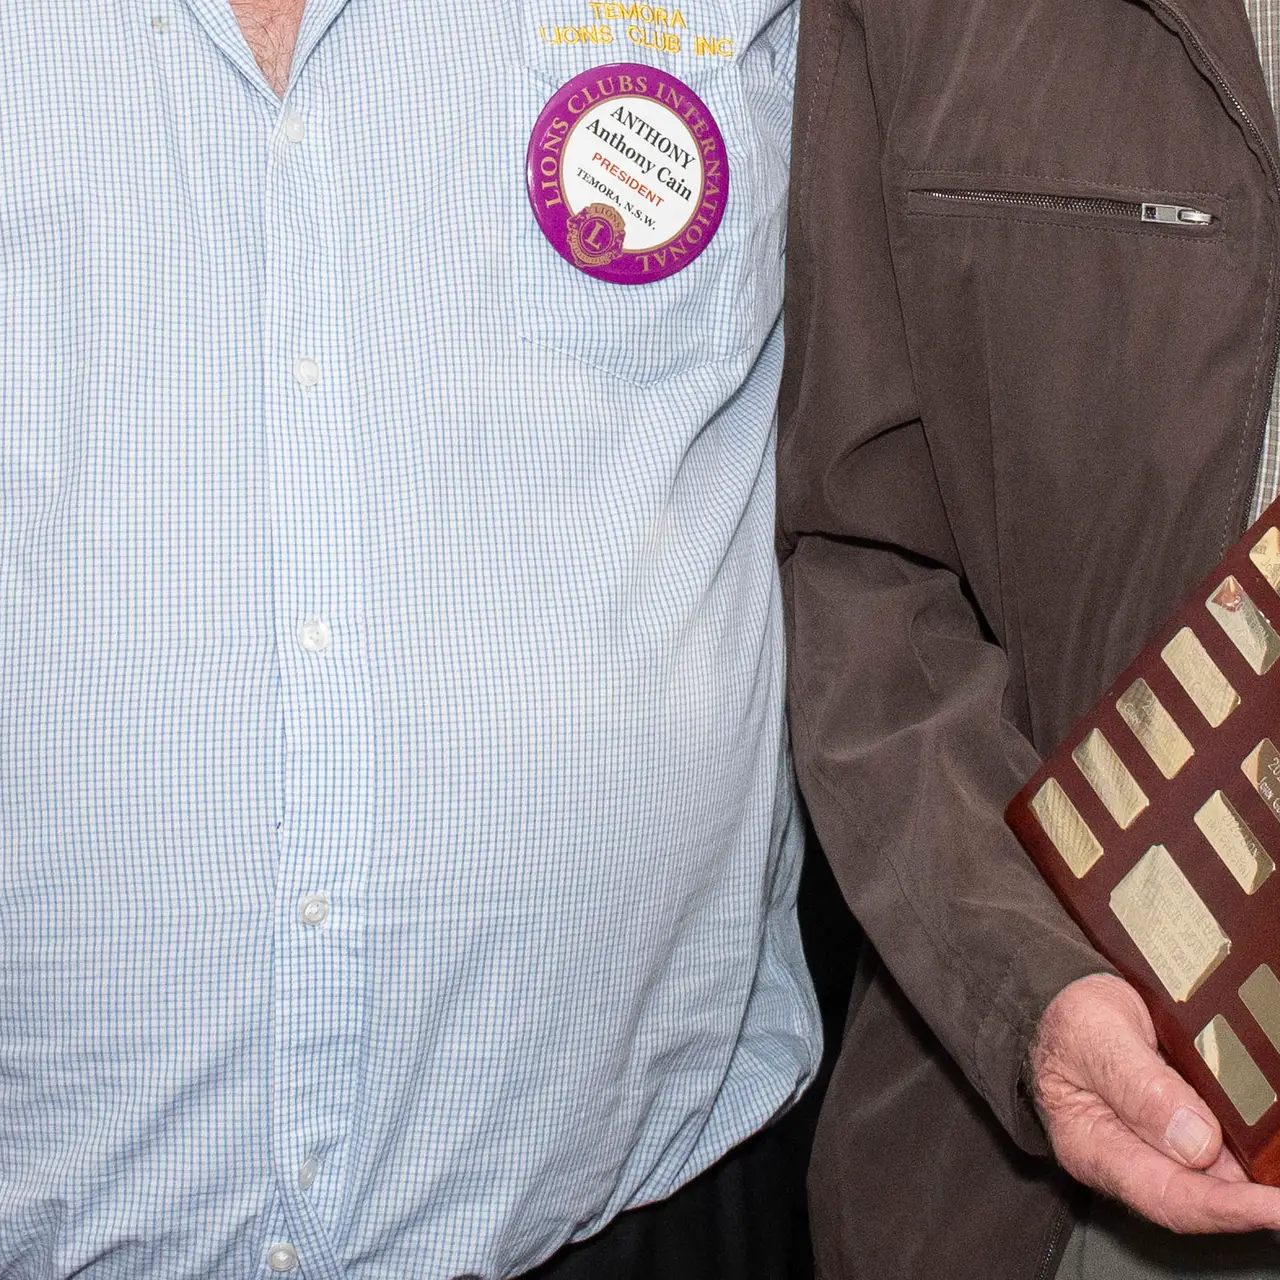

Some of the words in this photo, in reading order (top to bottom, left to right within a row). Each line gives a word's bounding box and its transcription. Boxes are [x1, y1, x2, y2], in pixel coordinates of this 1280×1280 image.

[540, 24, 614, 45] LIONS
[627, 25, 680, 55] CLUB
[695, 36, 733, 57] INC
[588, 2, 687, 29] TEMORA
[586, 118, 656, 174] Anthony
[657, 166, 692, 201] Cain
[610, 106, 696, 170] ANTHONY
[541, 116, 569, 208] LIONS
[567, 75, 648, 114] CLUBS
[636, 81, 720, 272] INTERNATIONAL
[576, 168, 622, 207] TEMORA,
[624, 202, 656, 230] N.S.W.
[592, 152, 664, 207] PRESIDENT
[584, 220, 605, 249] L
